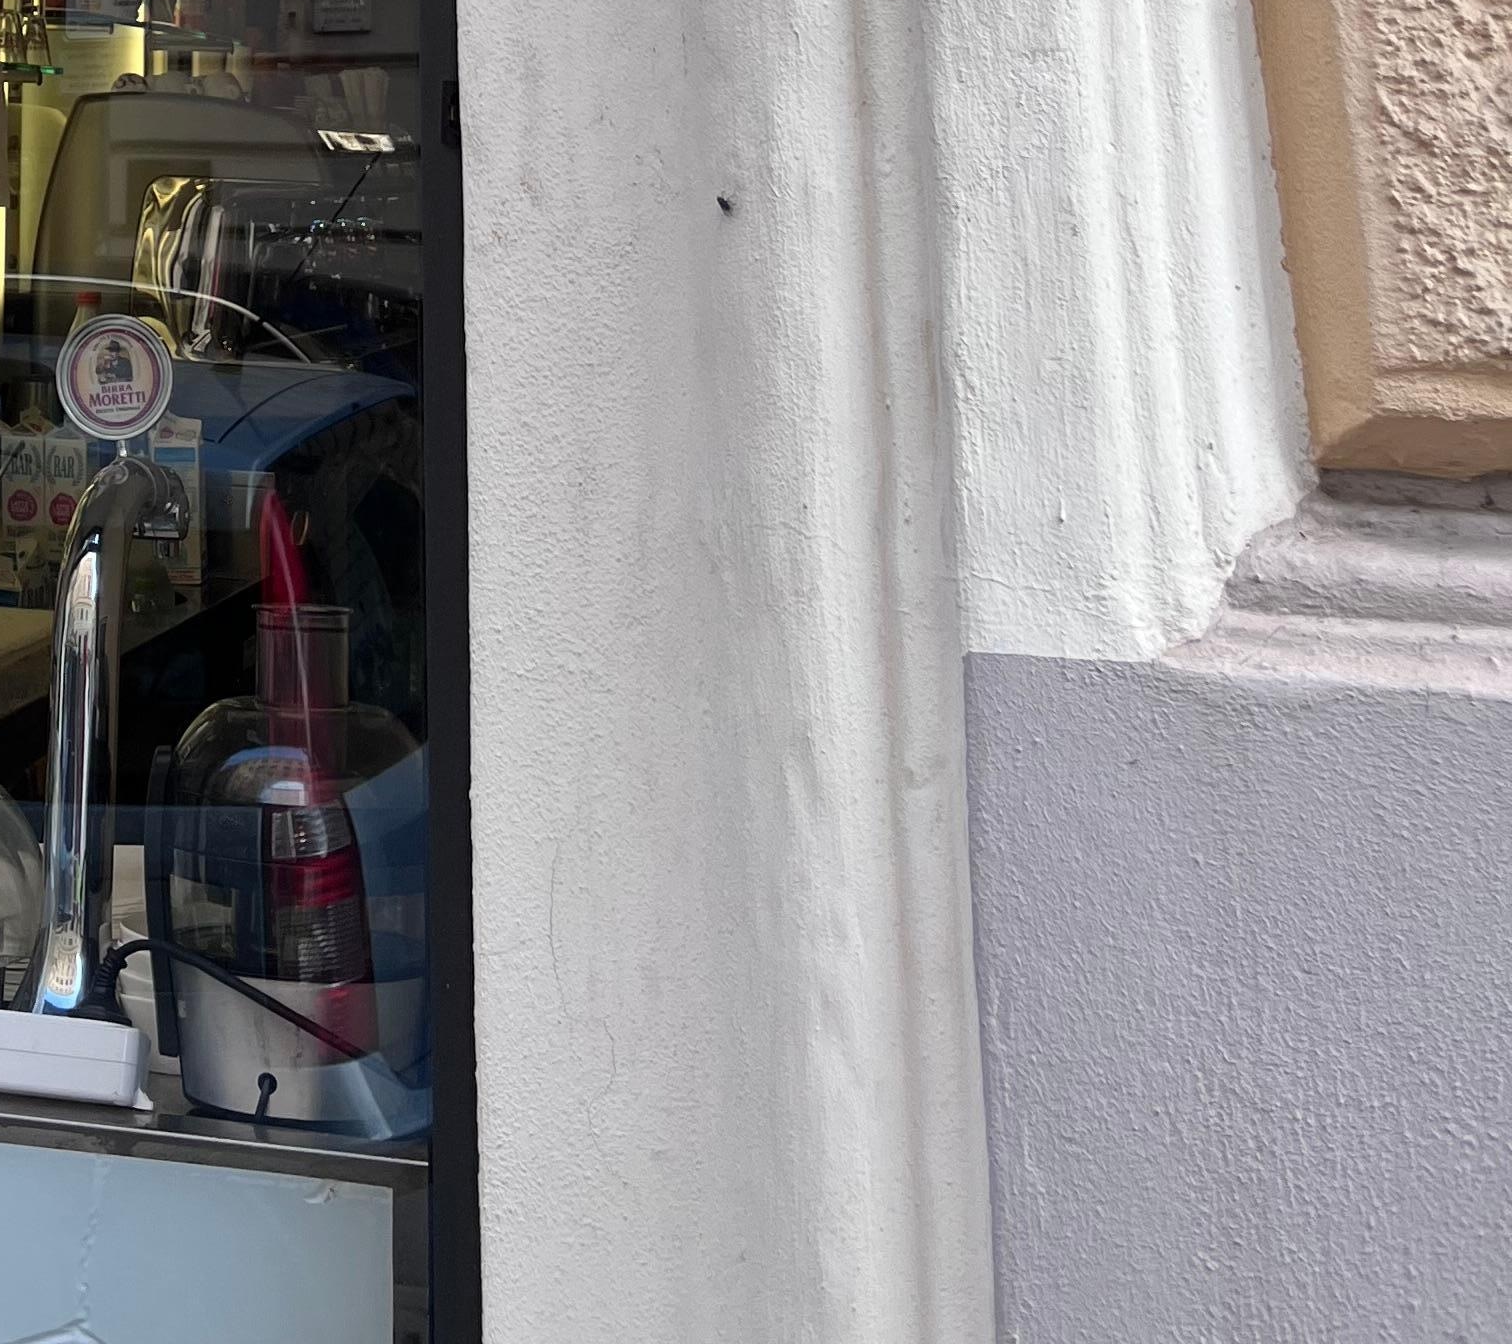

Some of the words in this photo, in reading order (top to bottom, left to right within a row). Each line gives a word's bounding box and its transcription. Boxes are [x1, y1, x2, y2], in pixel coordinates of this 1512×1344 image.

[101, 383, 133, 393] BIRRA
[89, 391, 146, 408] MORETTI
[54, 455, 75, 478] BAR
